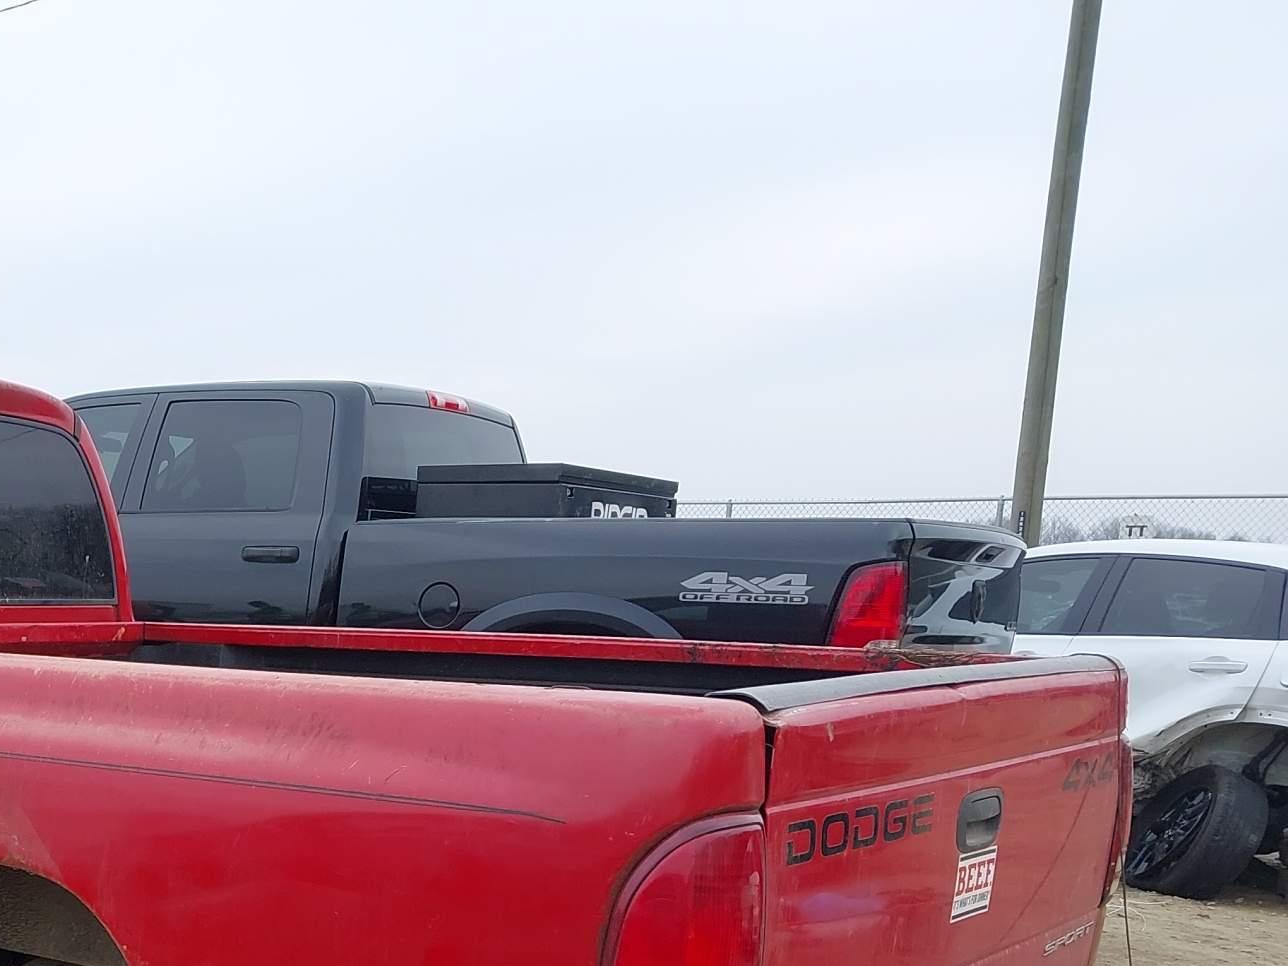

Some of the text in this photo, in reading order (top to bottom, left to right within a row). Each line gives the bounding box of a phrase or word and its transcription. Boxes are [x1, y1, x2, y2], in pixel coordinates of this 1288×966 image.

[681, 591, 807, 604] OFF ROAD
[786, 793, 935, 866] DODGE
[1042, 921, 1095, 956] SPORT
